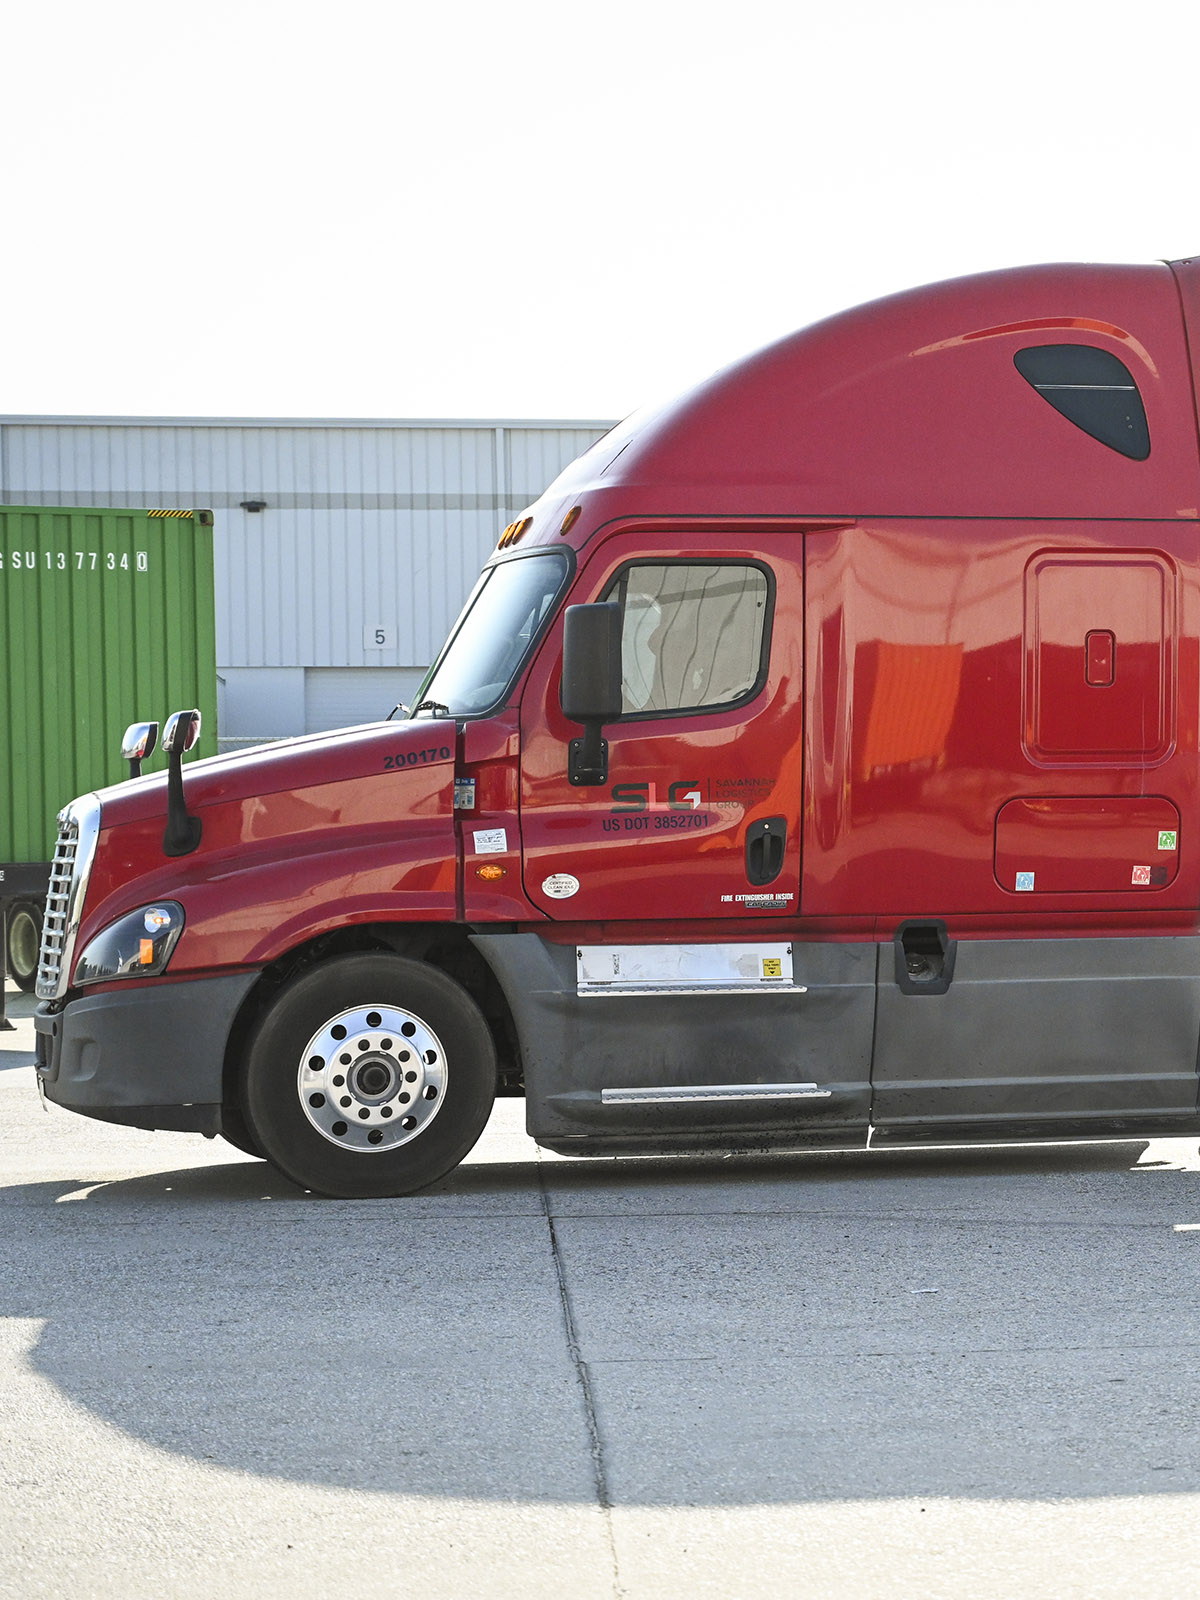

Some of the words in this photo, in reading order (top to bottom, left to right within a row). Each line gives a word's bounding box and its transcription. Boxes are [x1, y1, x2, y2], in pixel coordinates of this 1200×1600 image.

[375, 629, 386, 645] 5
[383, 746, 450, 769] 200170
[602, 818, 621, 832] US
[625, 817, 650, 831] DOT
[654, 814, 709, 830] 3852701
